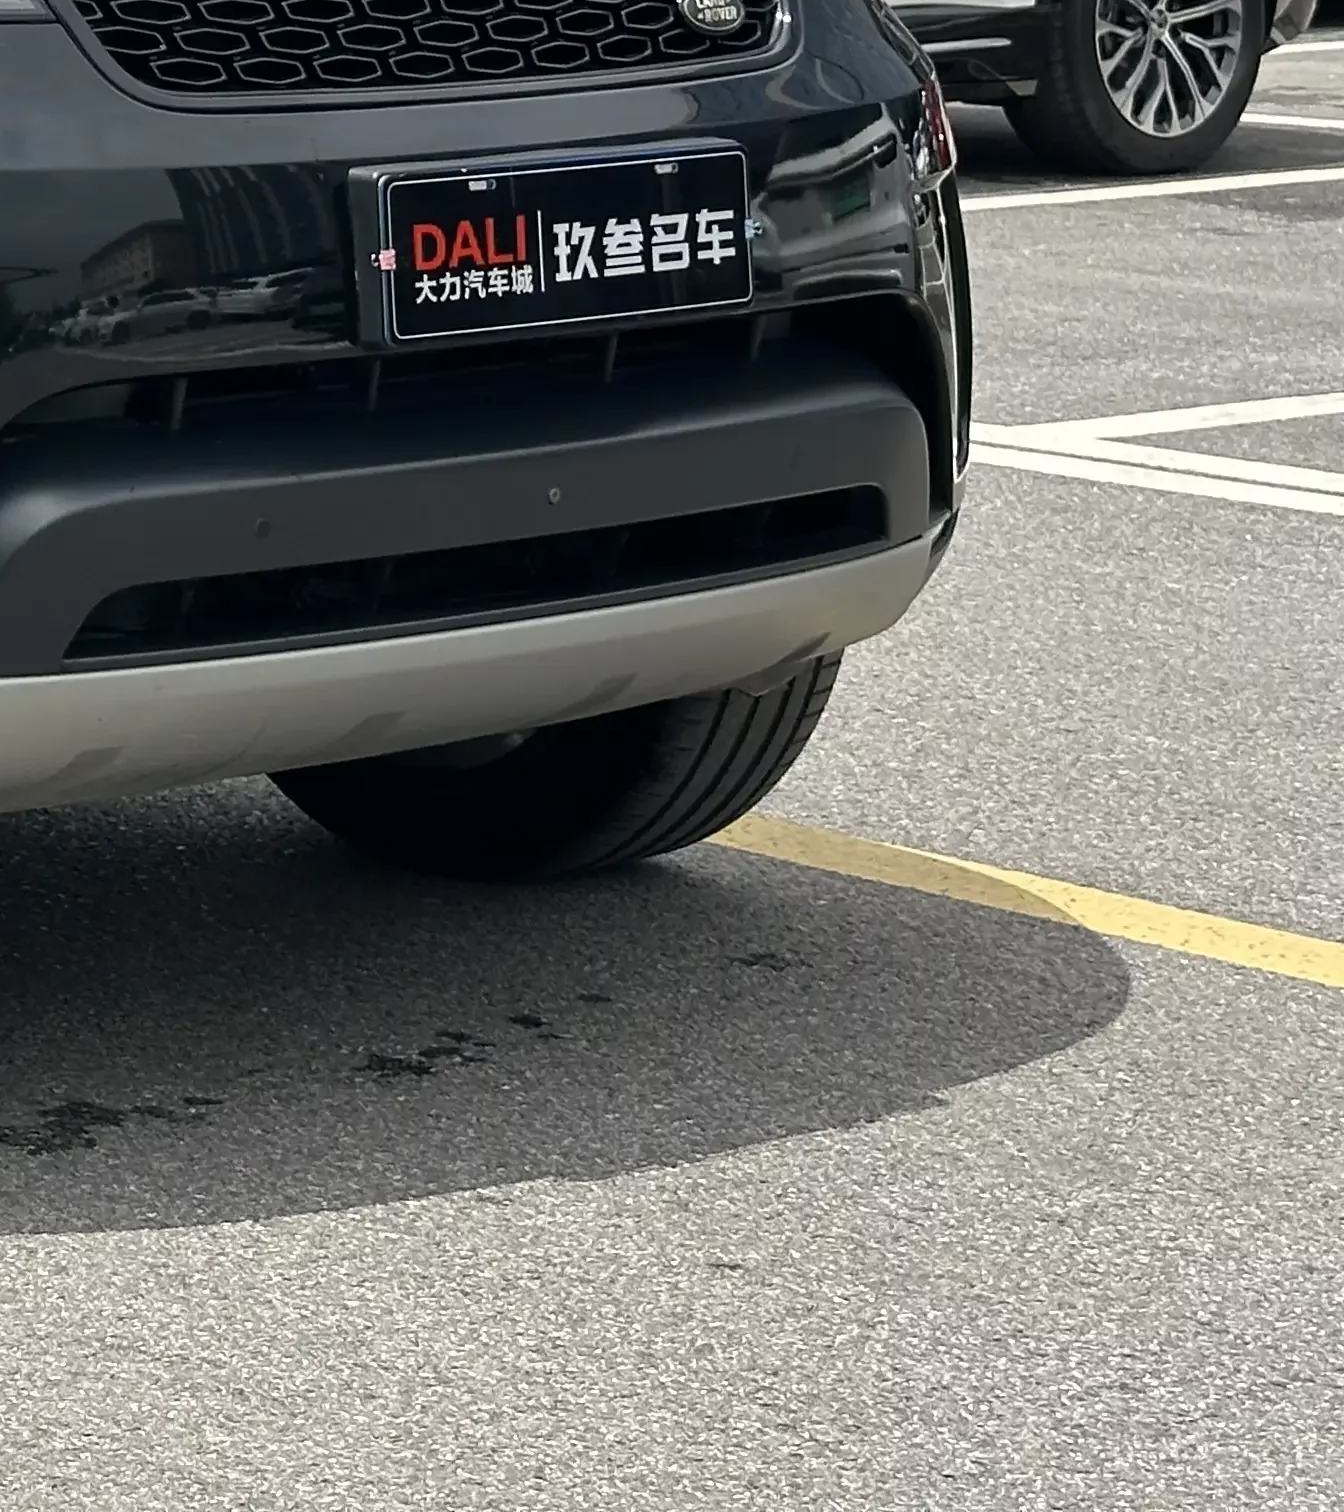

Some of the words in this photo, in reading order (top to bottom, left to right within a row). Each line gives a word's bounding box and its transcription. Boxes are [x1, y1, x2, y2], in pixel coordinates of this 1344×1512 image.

[705, 6, 737, 22] ROVER
[412, 214, 527, 272] DALI
[552, 207, 736, 283] 玖叁名车
[415, 264, 534, 304] 大力汽车城
